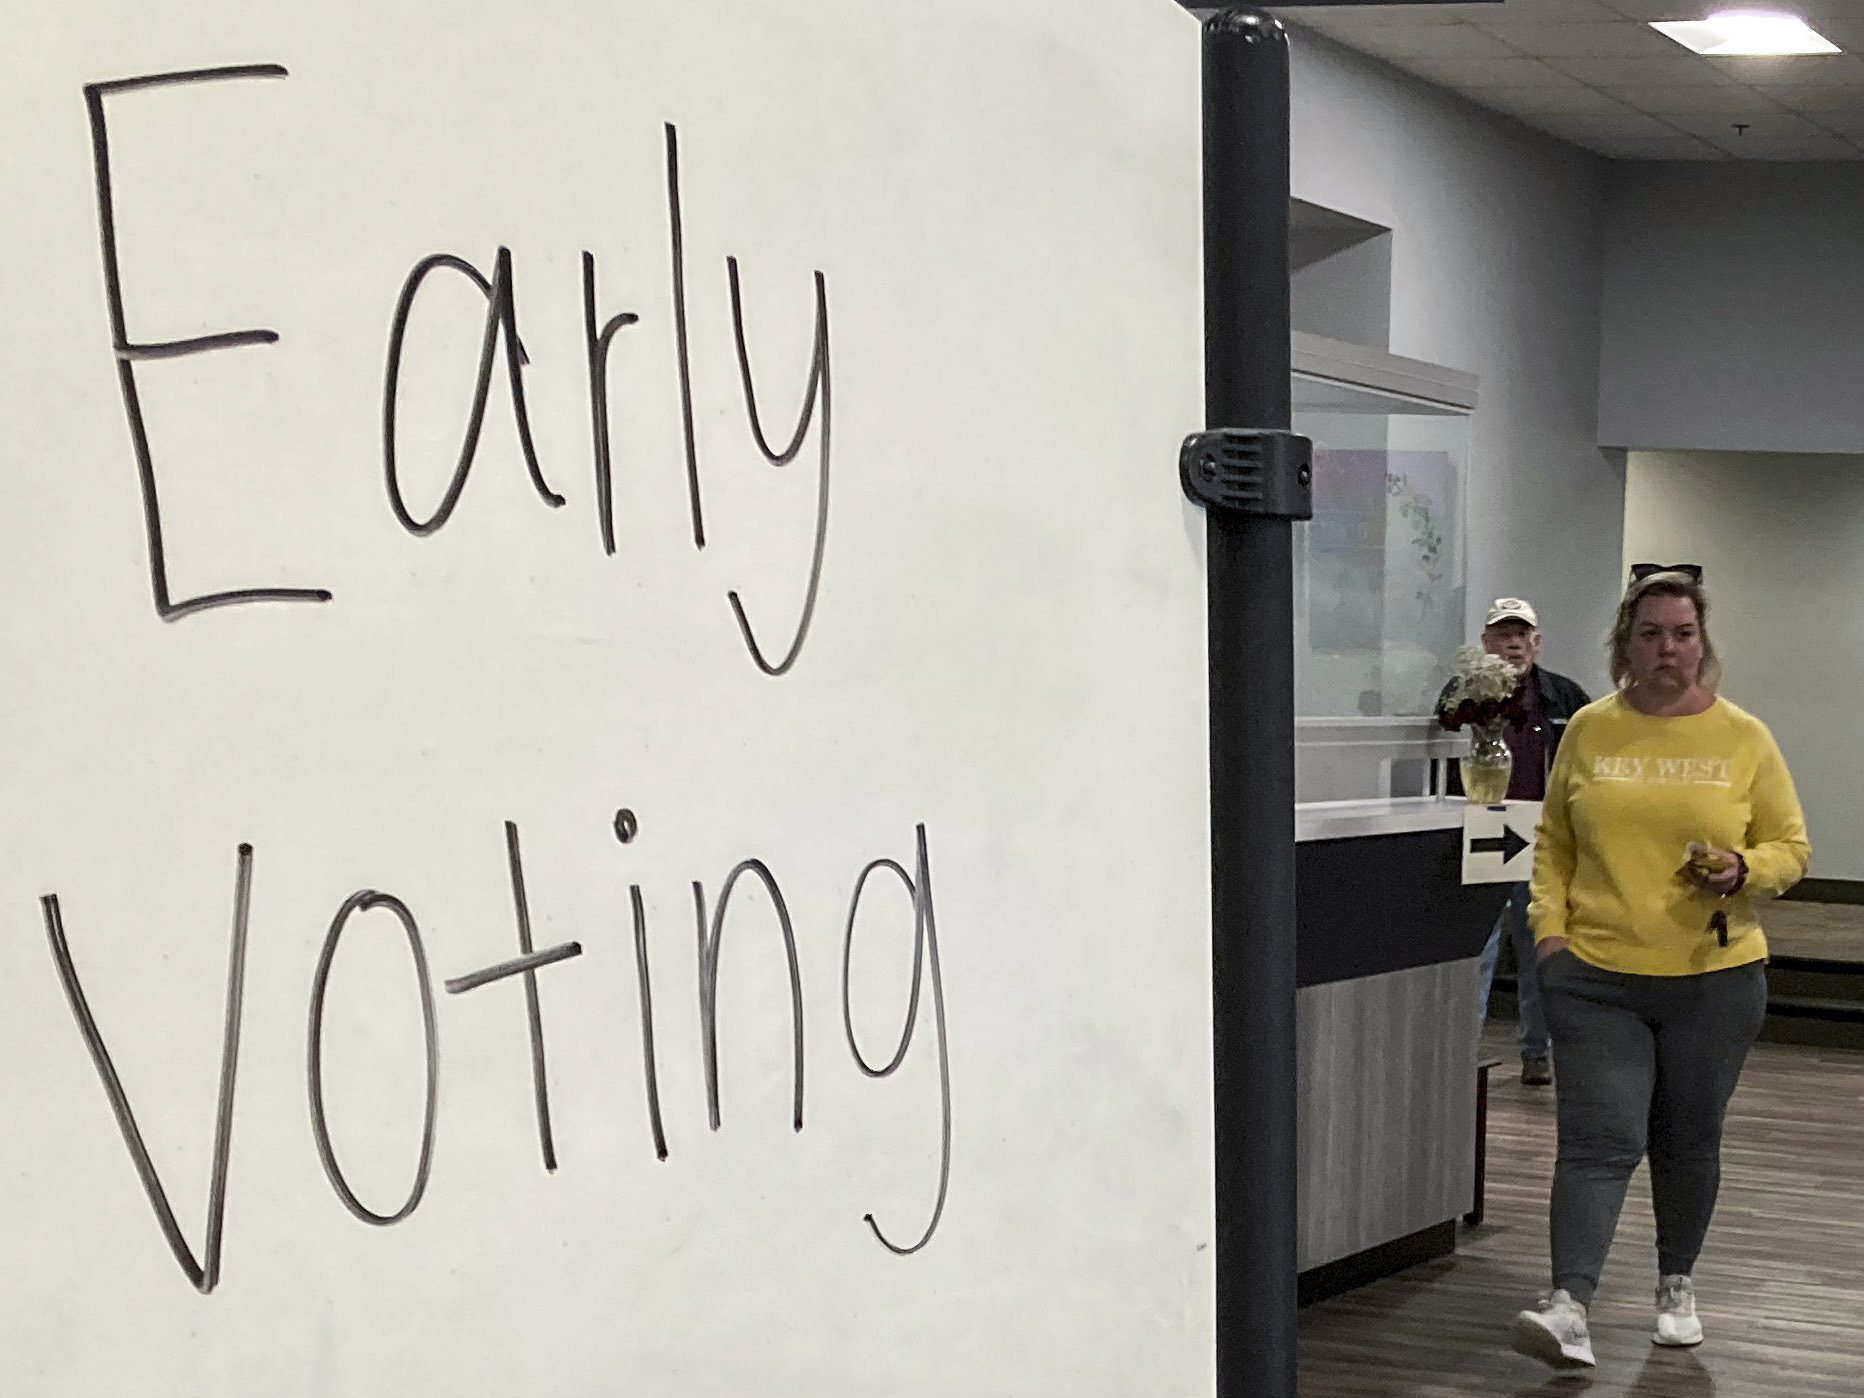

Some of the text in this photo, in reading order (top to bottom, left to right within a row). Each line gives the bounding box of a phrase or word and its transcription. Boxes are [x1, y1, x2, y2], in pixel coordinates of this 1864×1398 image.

[83, 63, 831, 676] Early
[1592, 755, 1731, 779] KEY WEST
